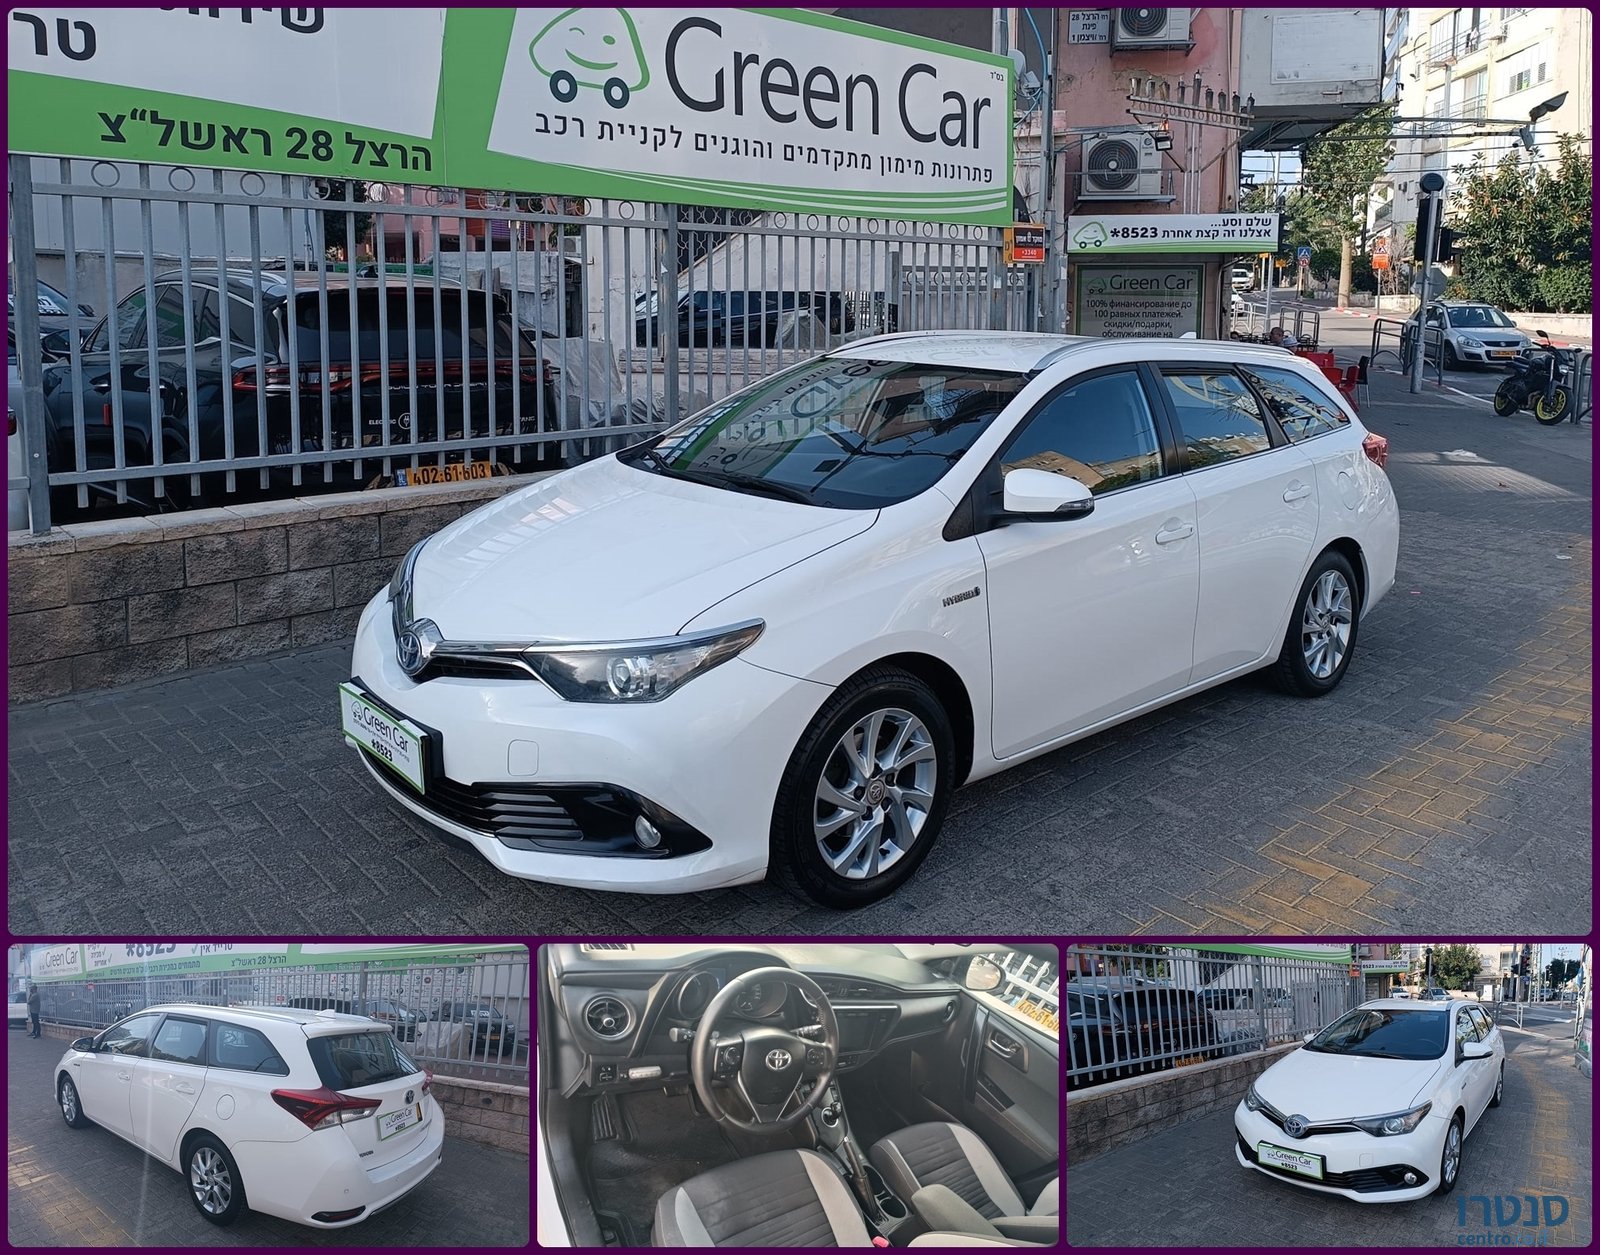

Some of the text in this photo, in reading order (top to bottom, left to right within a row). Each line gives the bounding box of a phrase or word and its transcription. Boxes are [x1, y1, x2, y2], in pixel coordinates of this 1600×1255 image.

[1071, 13, 1080, 21] 28
[1081, 12, 1100, 21] הרצל
[665, 16, 991, 149] Green Car
[286, 126, 334, 163] 28
[535, 111, 993, 183] פתרונות מימון מתקדמים והוגנים לקניית רכב
[344, 131, 432, 172] הרצל
[1245, 216, 1272, 227] שלם
[1161, 229, 1192, 239] אחרת
[1195, 229, 1220, 240] קצת
[1223, 229, 1237, 238] זה
[1239, 227, 1272, 238] אצלנו
[1109, 274, 1194, 290] Green Car
[1086, 299, 1192, 310] 100% финансирование до
[1094, 309, 1109, 318] 100
[1110, 310, 1141, 319] равных
[363, 706, 392, 741] Green
[392, 726, 408, 753] Car
[45, 946, 78, 968] Green Car
[257, 955, 267, 965] 28
[268, 955, 287, 965] הרצל
[391, 1112, 404, 1123] Green
[404, 1109, 412, 1117] Car
[1275, 1150, 1298, 1162] Green
[1298, 1156, 1312, 1166] Car
